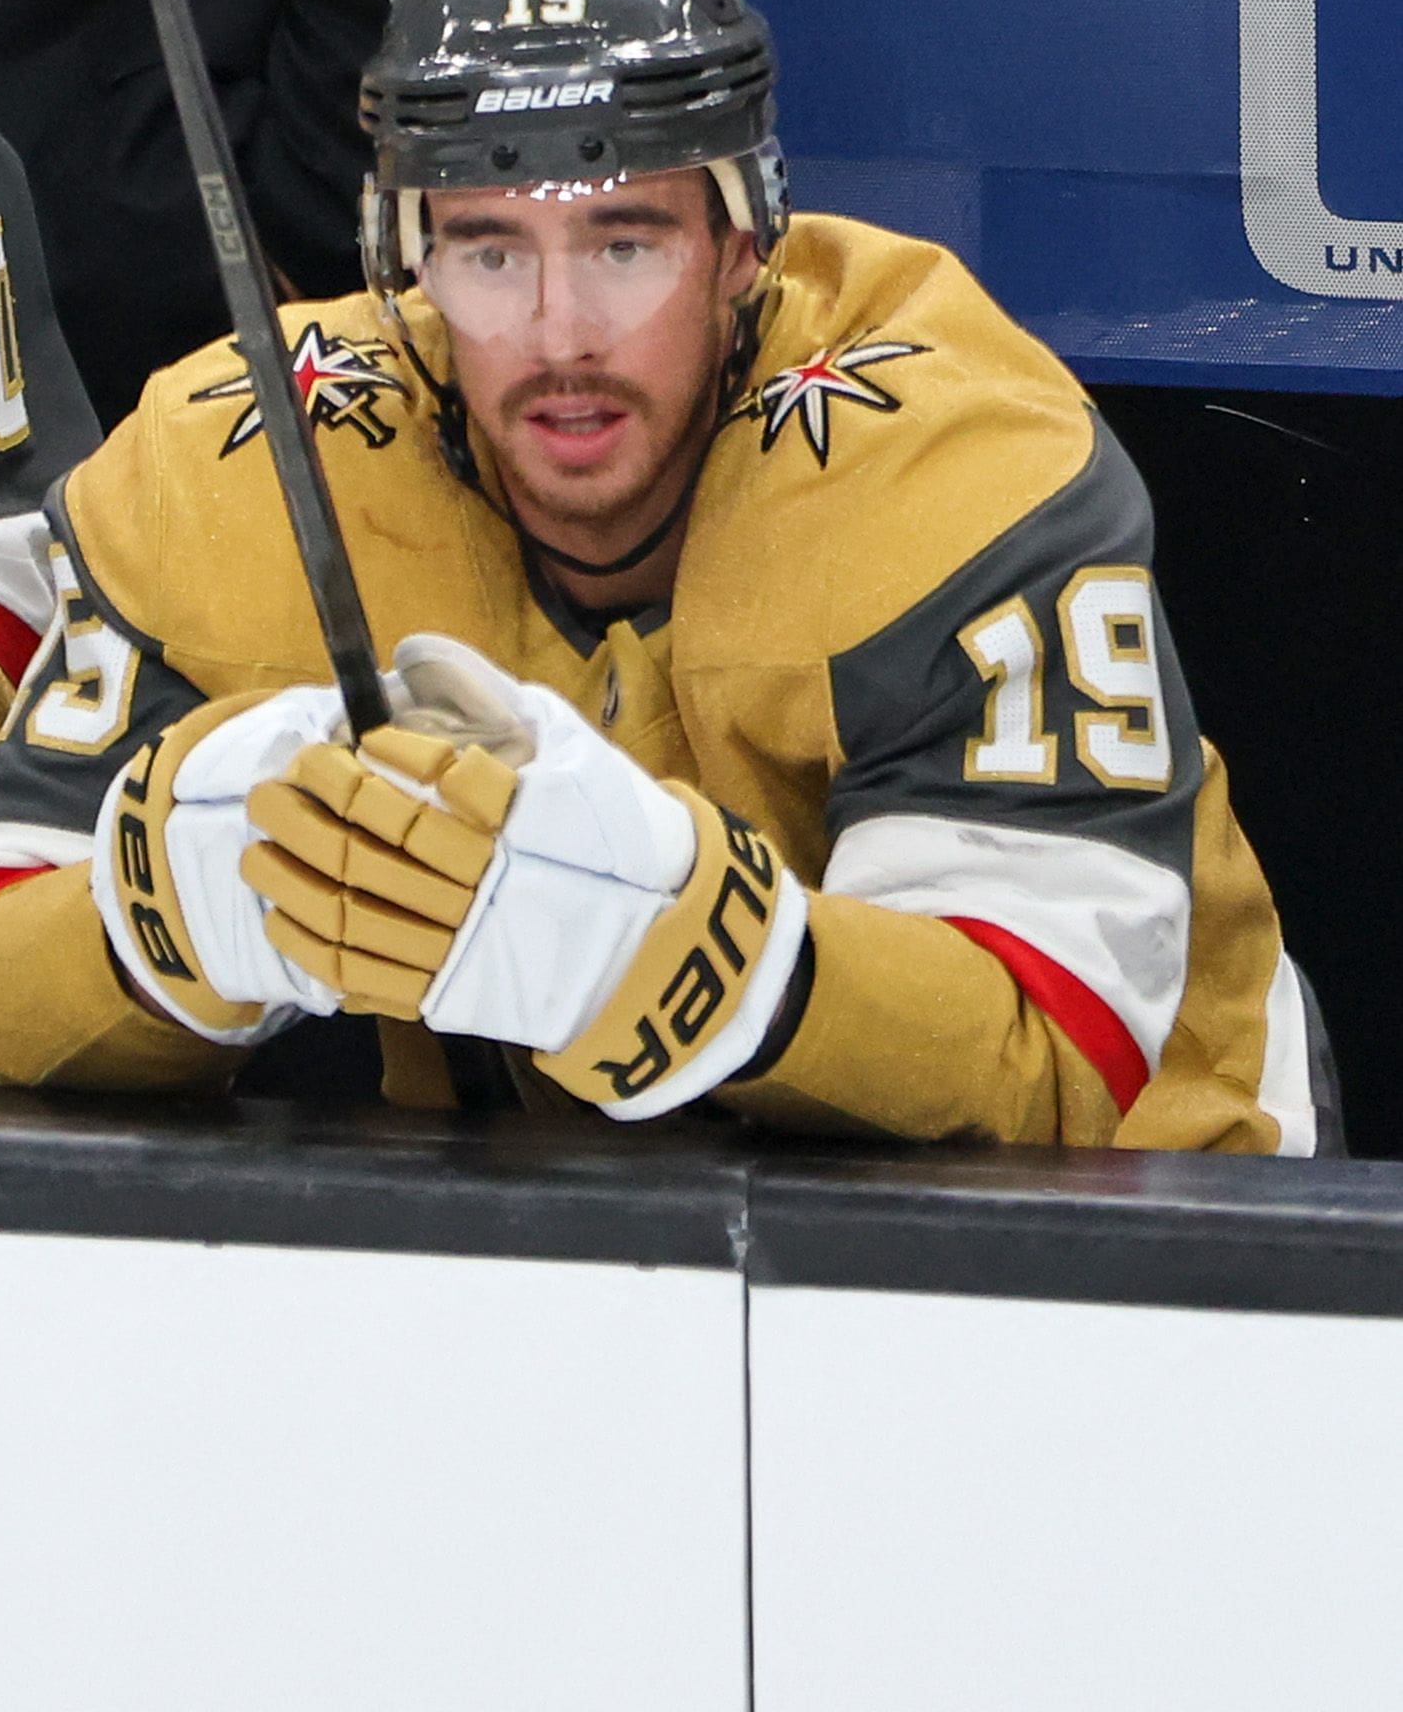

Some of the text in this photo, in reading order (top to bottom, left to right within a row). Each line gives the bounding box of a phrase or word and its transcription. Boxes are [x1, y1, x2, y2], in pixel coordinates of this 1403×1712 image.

[475, 79, 615, 113] BAUER
[956, 564, 1174, 794] 19
[592, 806, 774, 1099] AUER
